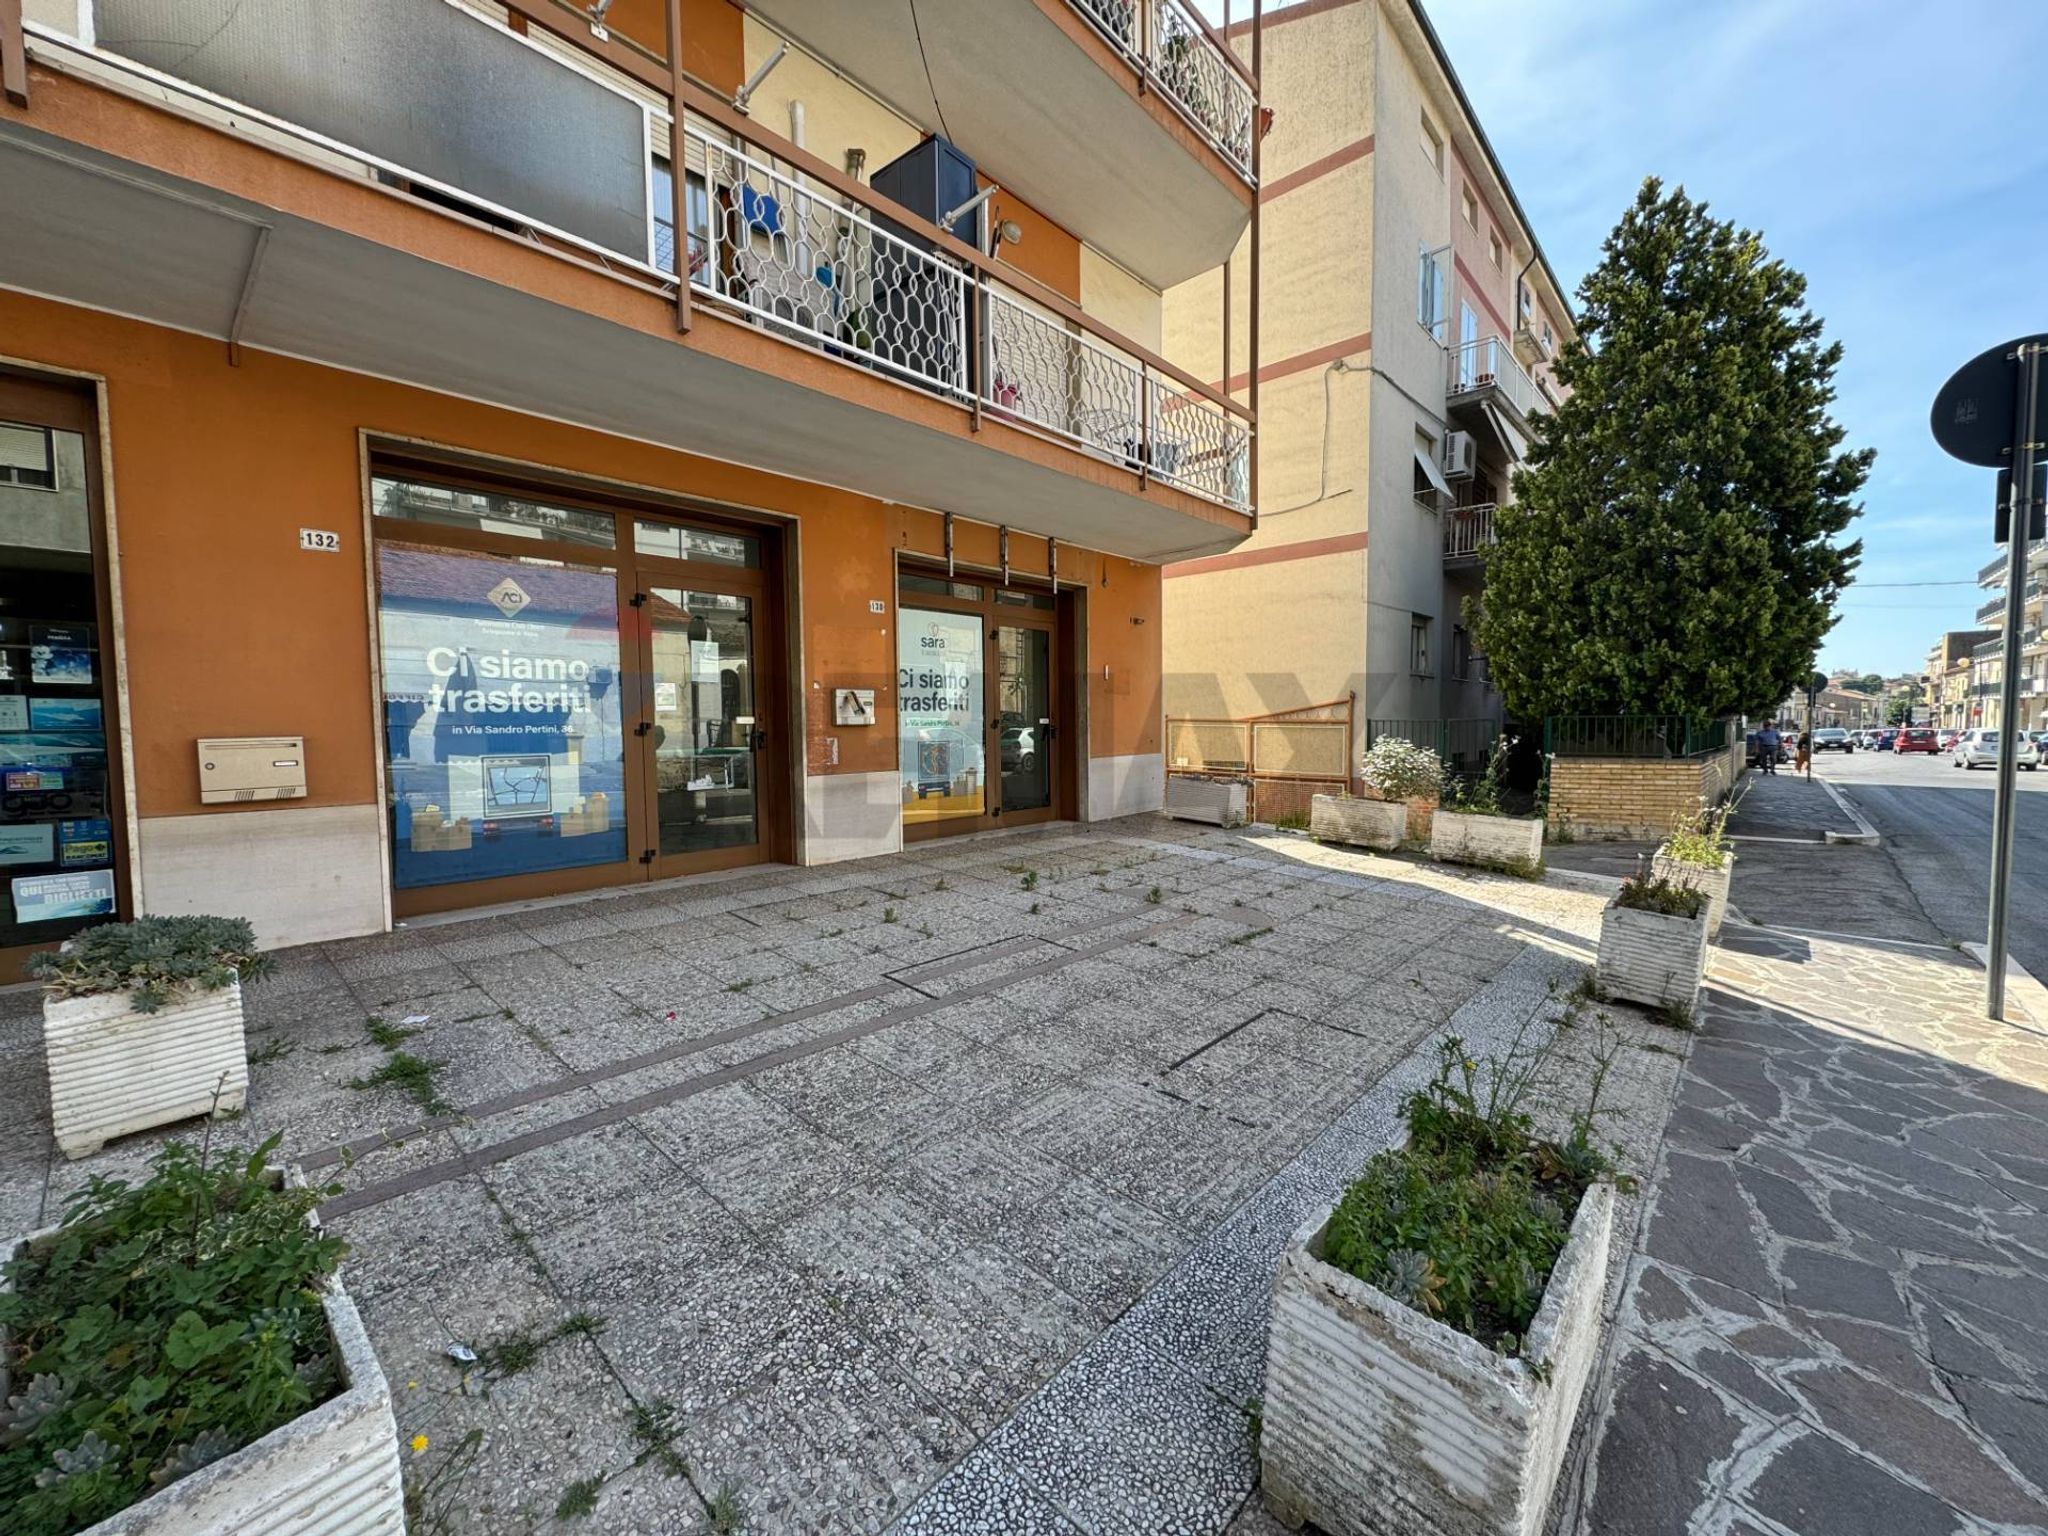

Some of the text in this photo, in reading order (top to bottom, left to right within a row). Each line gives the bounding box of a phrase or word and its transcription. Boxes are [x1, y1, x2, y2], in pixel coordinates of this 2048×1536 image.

[306, 532, 336, 549] 132
[501, 592, 522, 604] ACI
[921, 637, 945, 649] sara
[426, 647, 589, 681] Ci siamo
[919, 669, 969, 690] siamo
[428, 683, 592, 713] trasferiti
[452, 726, 463, 734] in
[465, 725, 482, 735] Via
[484, 726, 523, 734] Sandro
[525, 725, 560, 734] Pertini,
